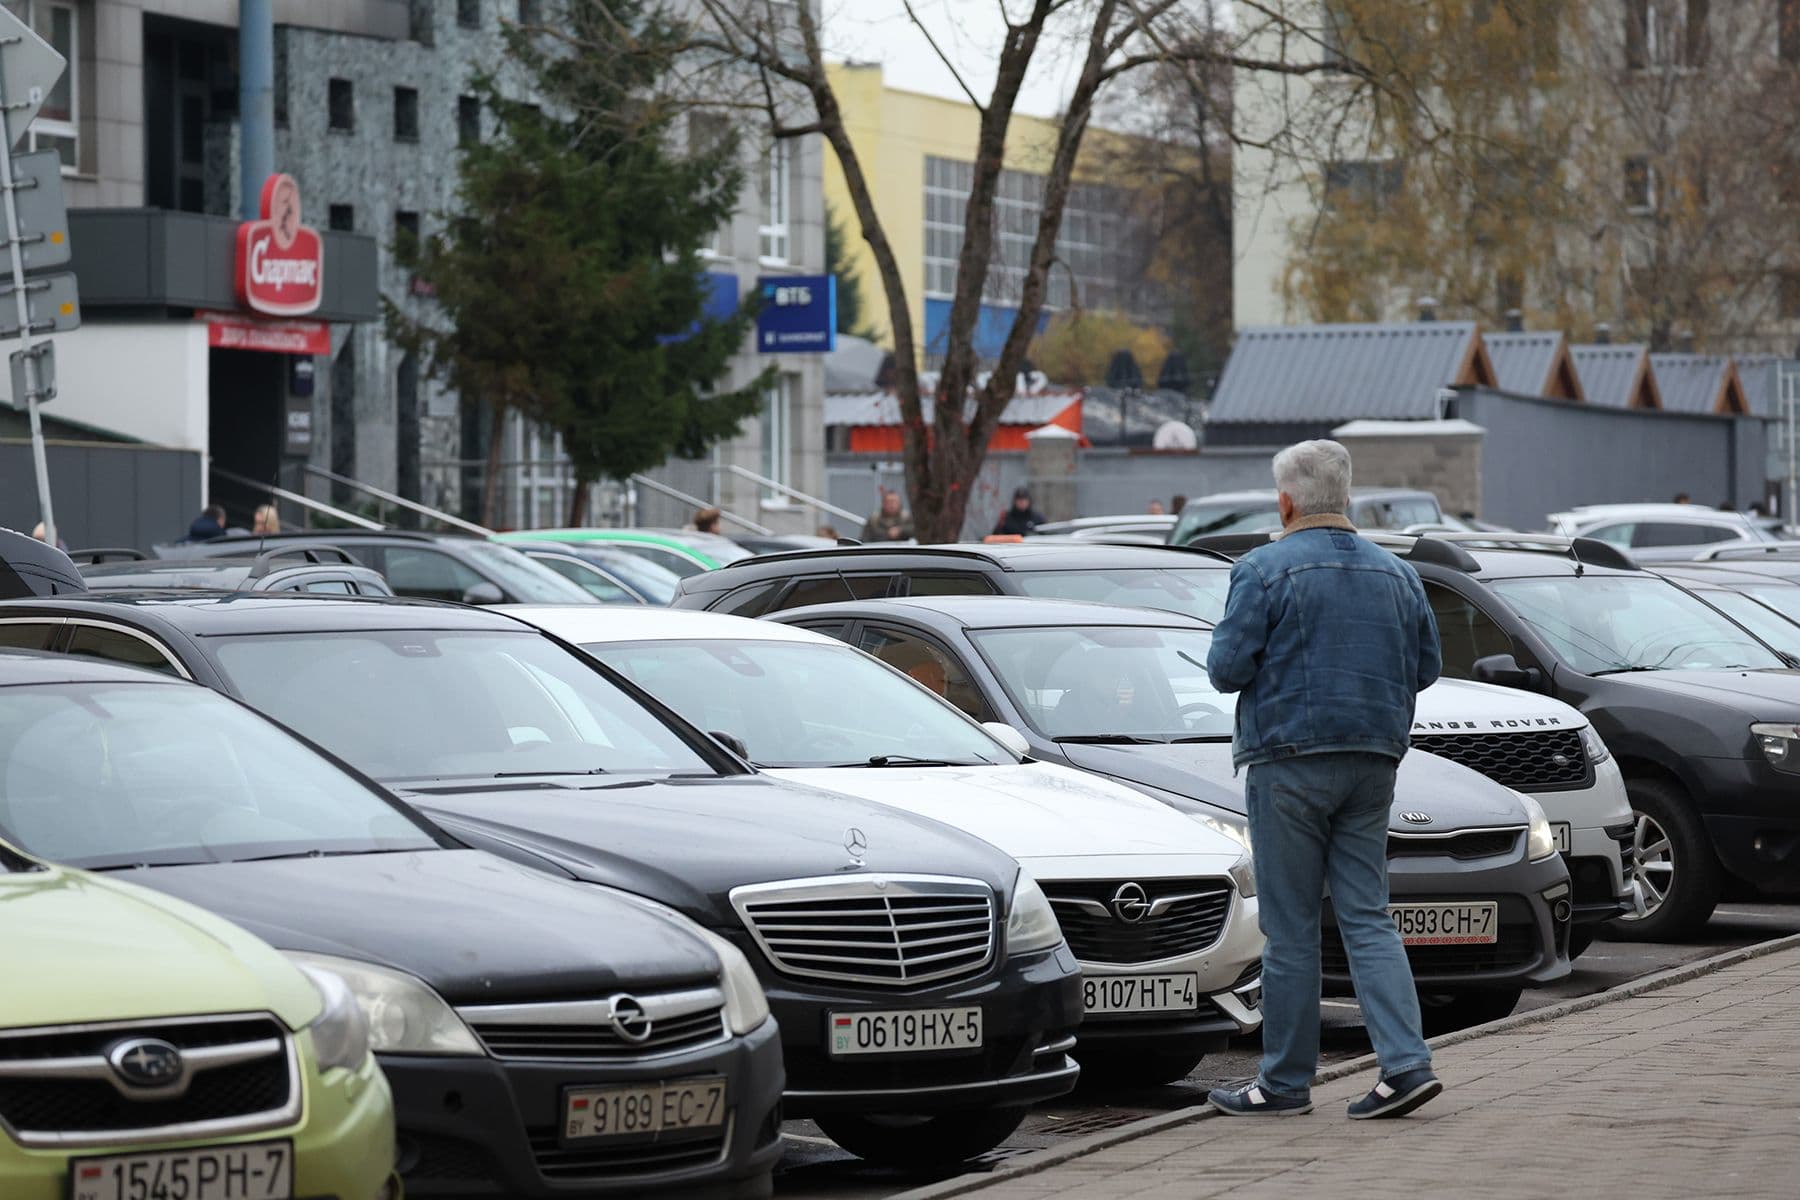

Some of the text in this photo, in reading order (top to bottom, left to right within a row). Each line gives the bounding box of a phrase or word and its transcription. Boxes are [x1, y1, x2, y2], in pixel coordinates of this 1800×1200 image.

[1413, 717, 1561, 730] ANGE ROVER
[836, 1036, 850, 1050] BY
[569, 1120, 585, 1135] BY
